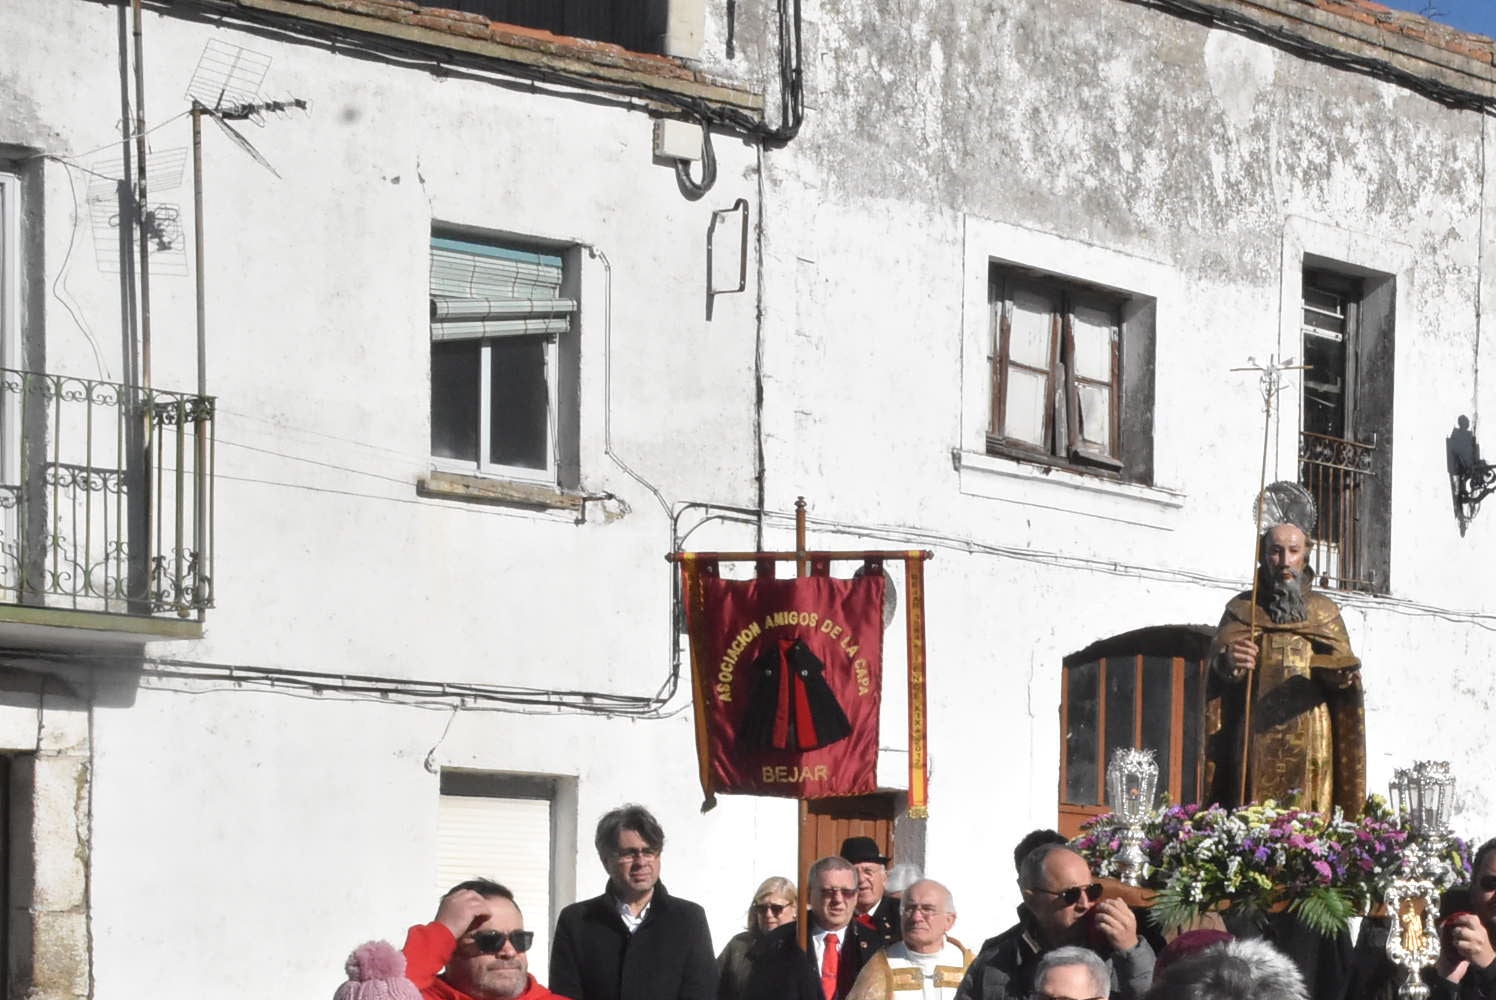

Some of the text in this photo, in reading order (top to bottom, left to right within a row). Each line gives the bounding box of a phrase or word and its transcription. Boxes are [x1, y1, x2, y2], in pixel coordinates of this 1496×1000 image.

[717, 611, 870, 702] ASOCIACION AMIGOS DE LA CAPA
[762, 765, 828, 783] BEJAR
